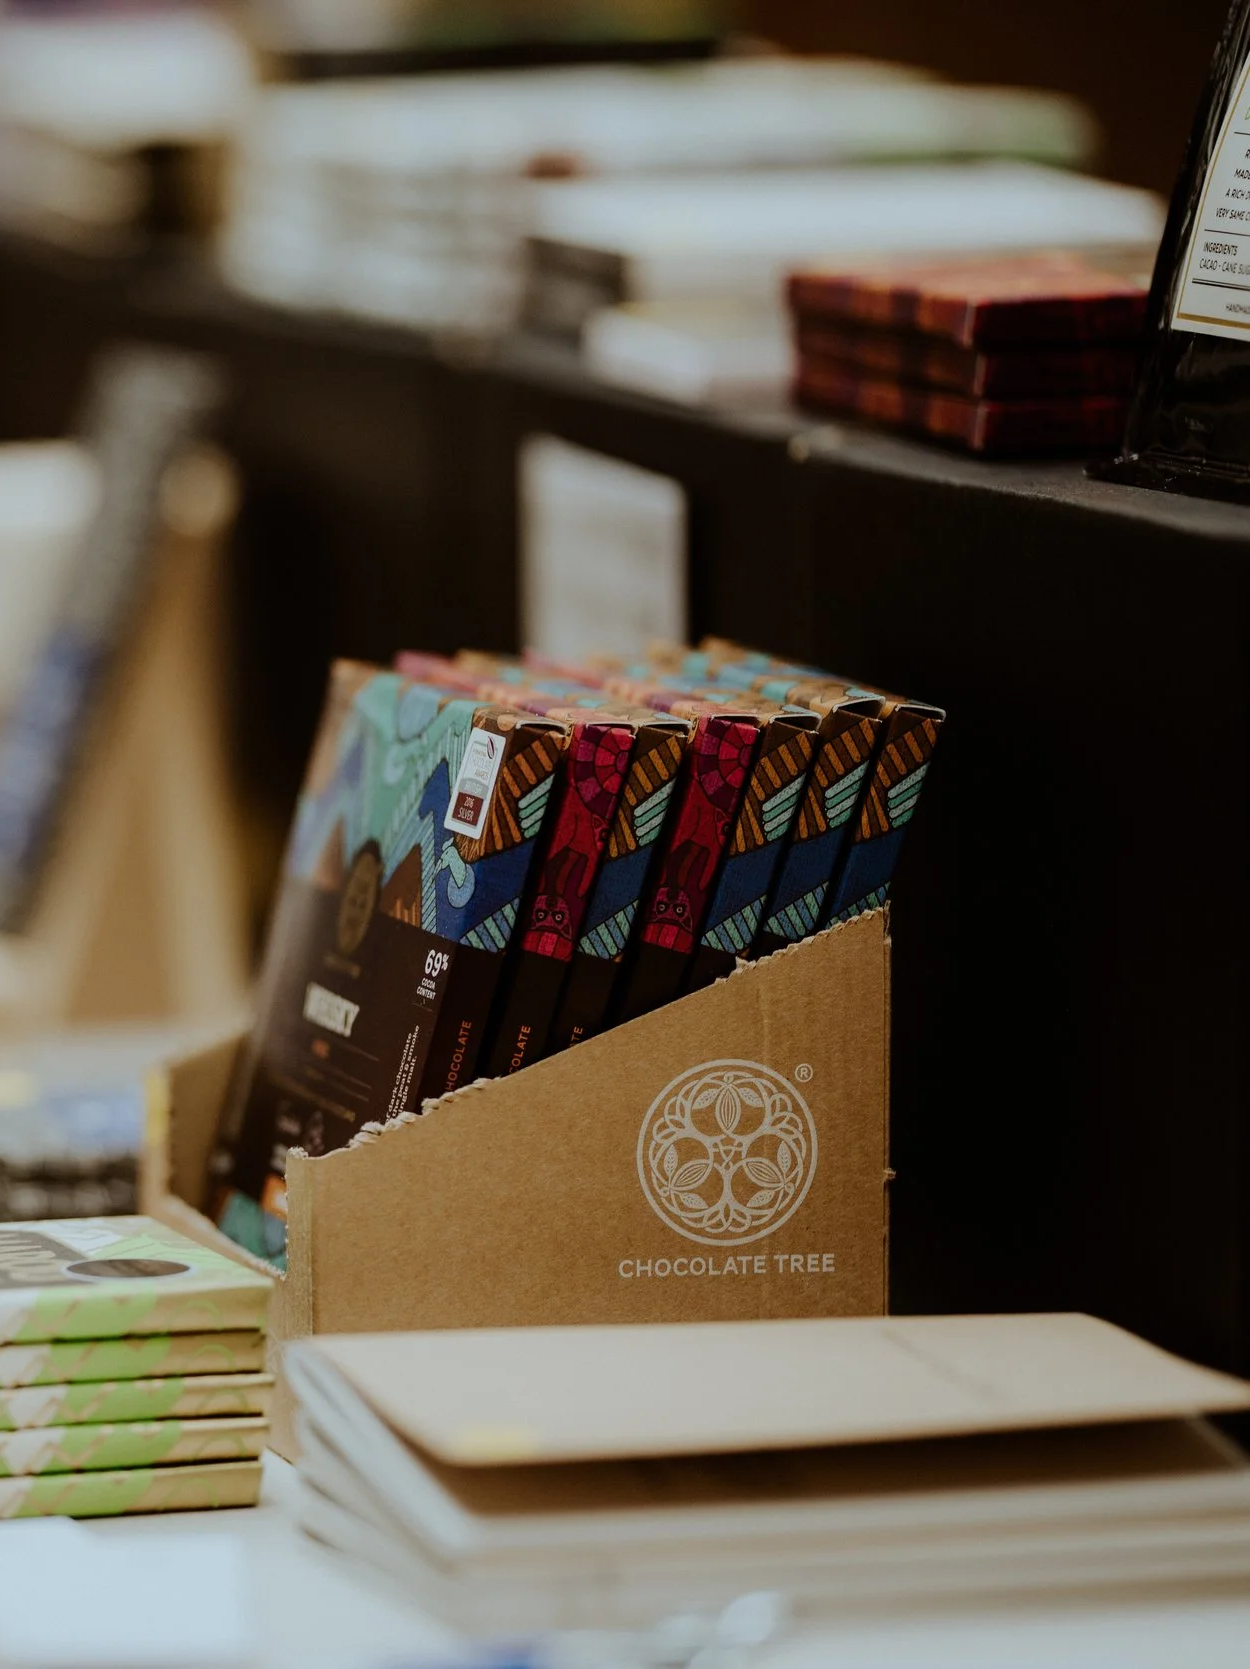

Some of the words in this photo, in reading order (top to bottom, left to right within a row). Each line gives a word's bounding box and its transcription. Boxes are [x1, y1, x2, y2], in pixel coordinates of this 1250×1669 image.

[1215, 207, 1230, 218] VERY
[1203, 241, 1238, 256] INGREDIENTS
[1199, 258, 1218, 271] CACAO
[1222, 261, 1237, 274] CANE
[1238, 264, 1250, 276] SUG
[457, 806, 475, 822] SILVER
[425, 949, 449, 977] 69%
[416, 986, 436, 1000] CONTENT
[421, 978, 436, 990] COCOA
[445, 1020, 472, 1091] HOCOLATE
[509, 1025, 531, 1074] COLATE
[388, 1086, 398, 1112] dark
[395, 1033, 412, 1085] chocolate
[392, 1099, 400, 1117] the
[397, 1073, 407, 1098] peat
[407, 1025, 420, 1061] smoke
[398, 1085, 409, 1113] ingle
[406, 1055, 418, 1083] malt.
[618, 1255, 767, 1278] CHOCOLATE
[773, 1253, 836, 1273] TREE
